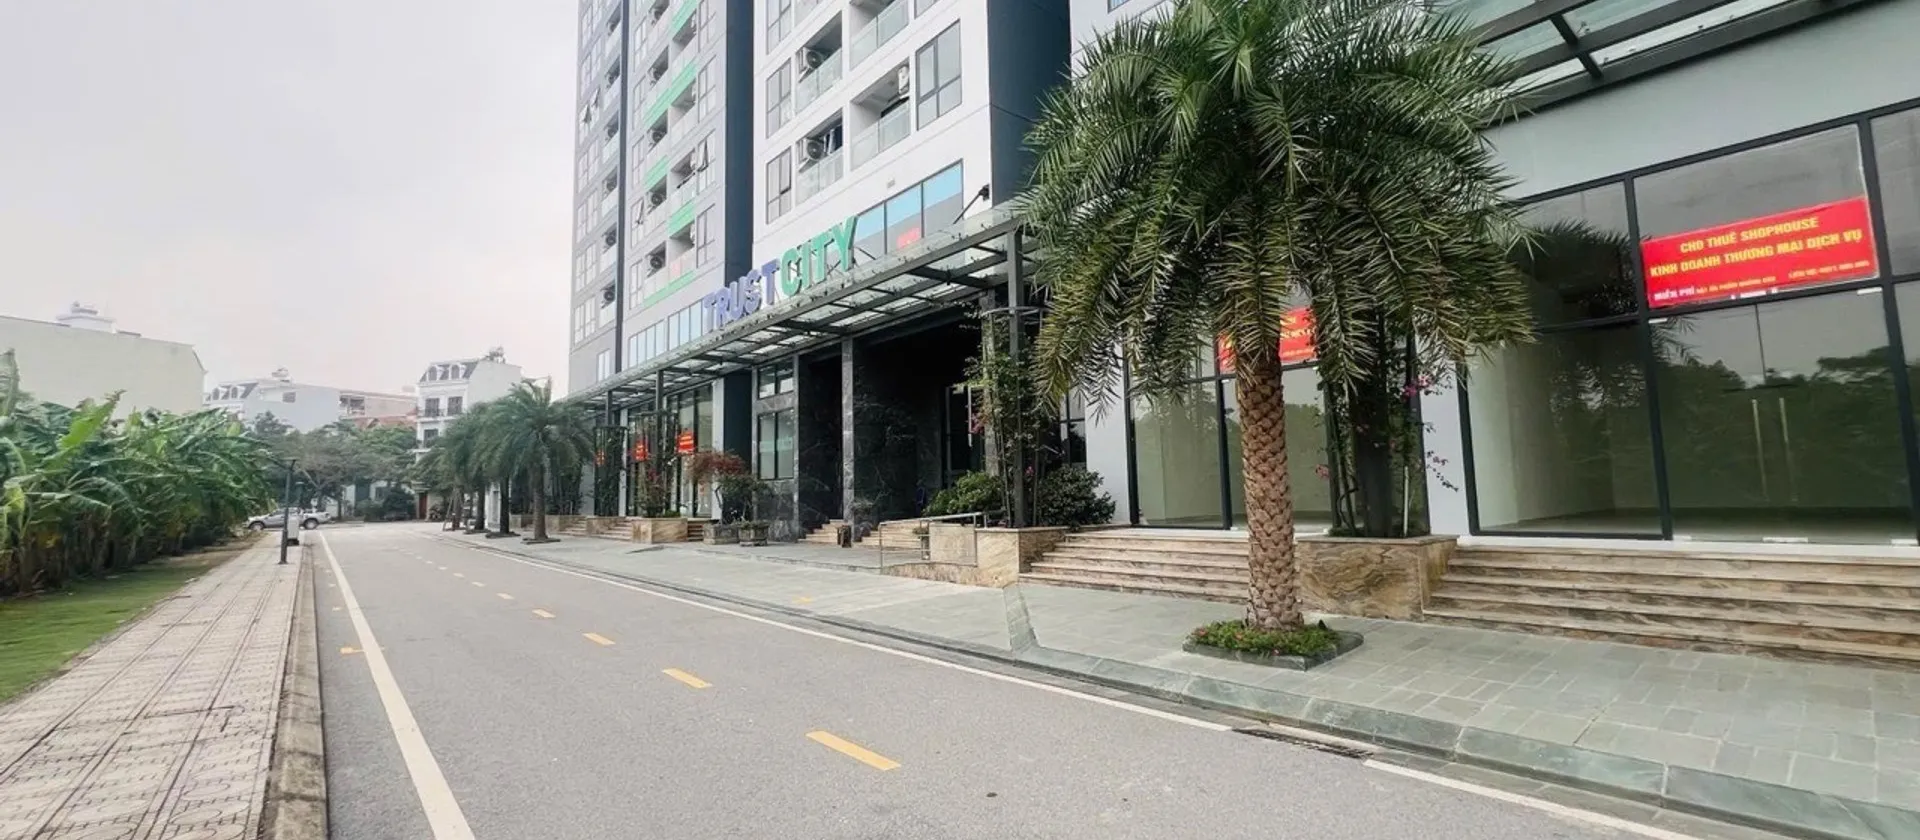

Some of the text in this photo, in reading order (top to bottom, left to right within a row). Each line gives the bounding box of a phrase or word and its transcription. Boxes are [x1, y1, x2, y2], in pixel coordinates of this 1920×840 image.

[1680, 216, 1819, 254] CHO THUÊ SHOPHOUSE
[703, 215, 858, 335] TRUST CITY
[1650, 263, 1679, 277] KINH
[1681, 255, 1721, 272] DOANH
